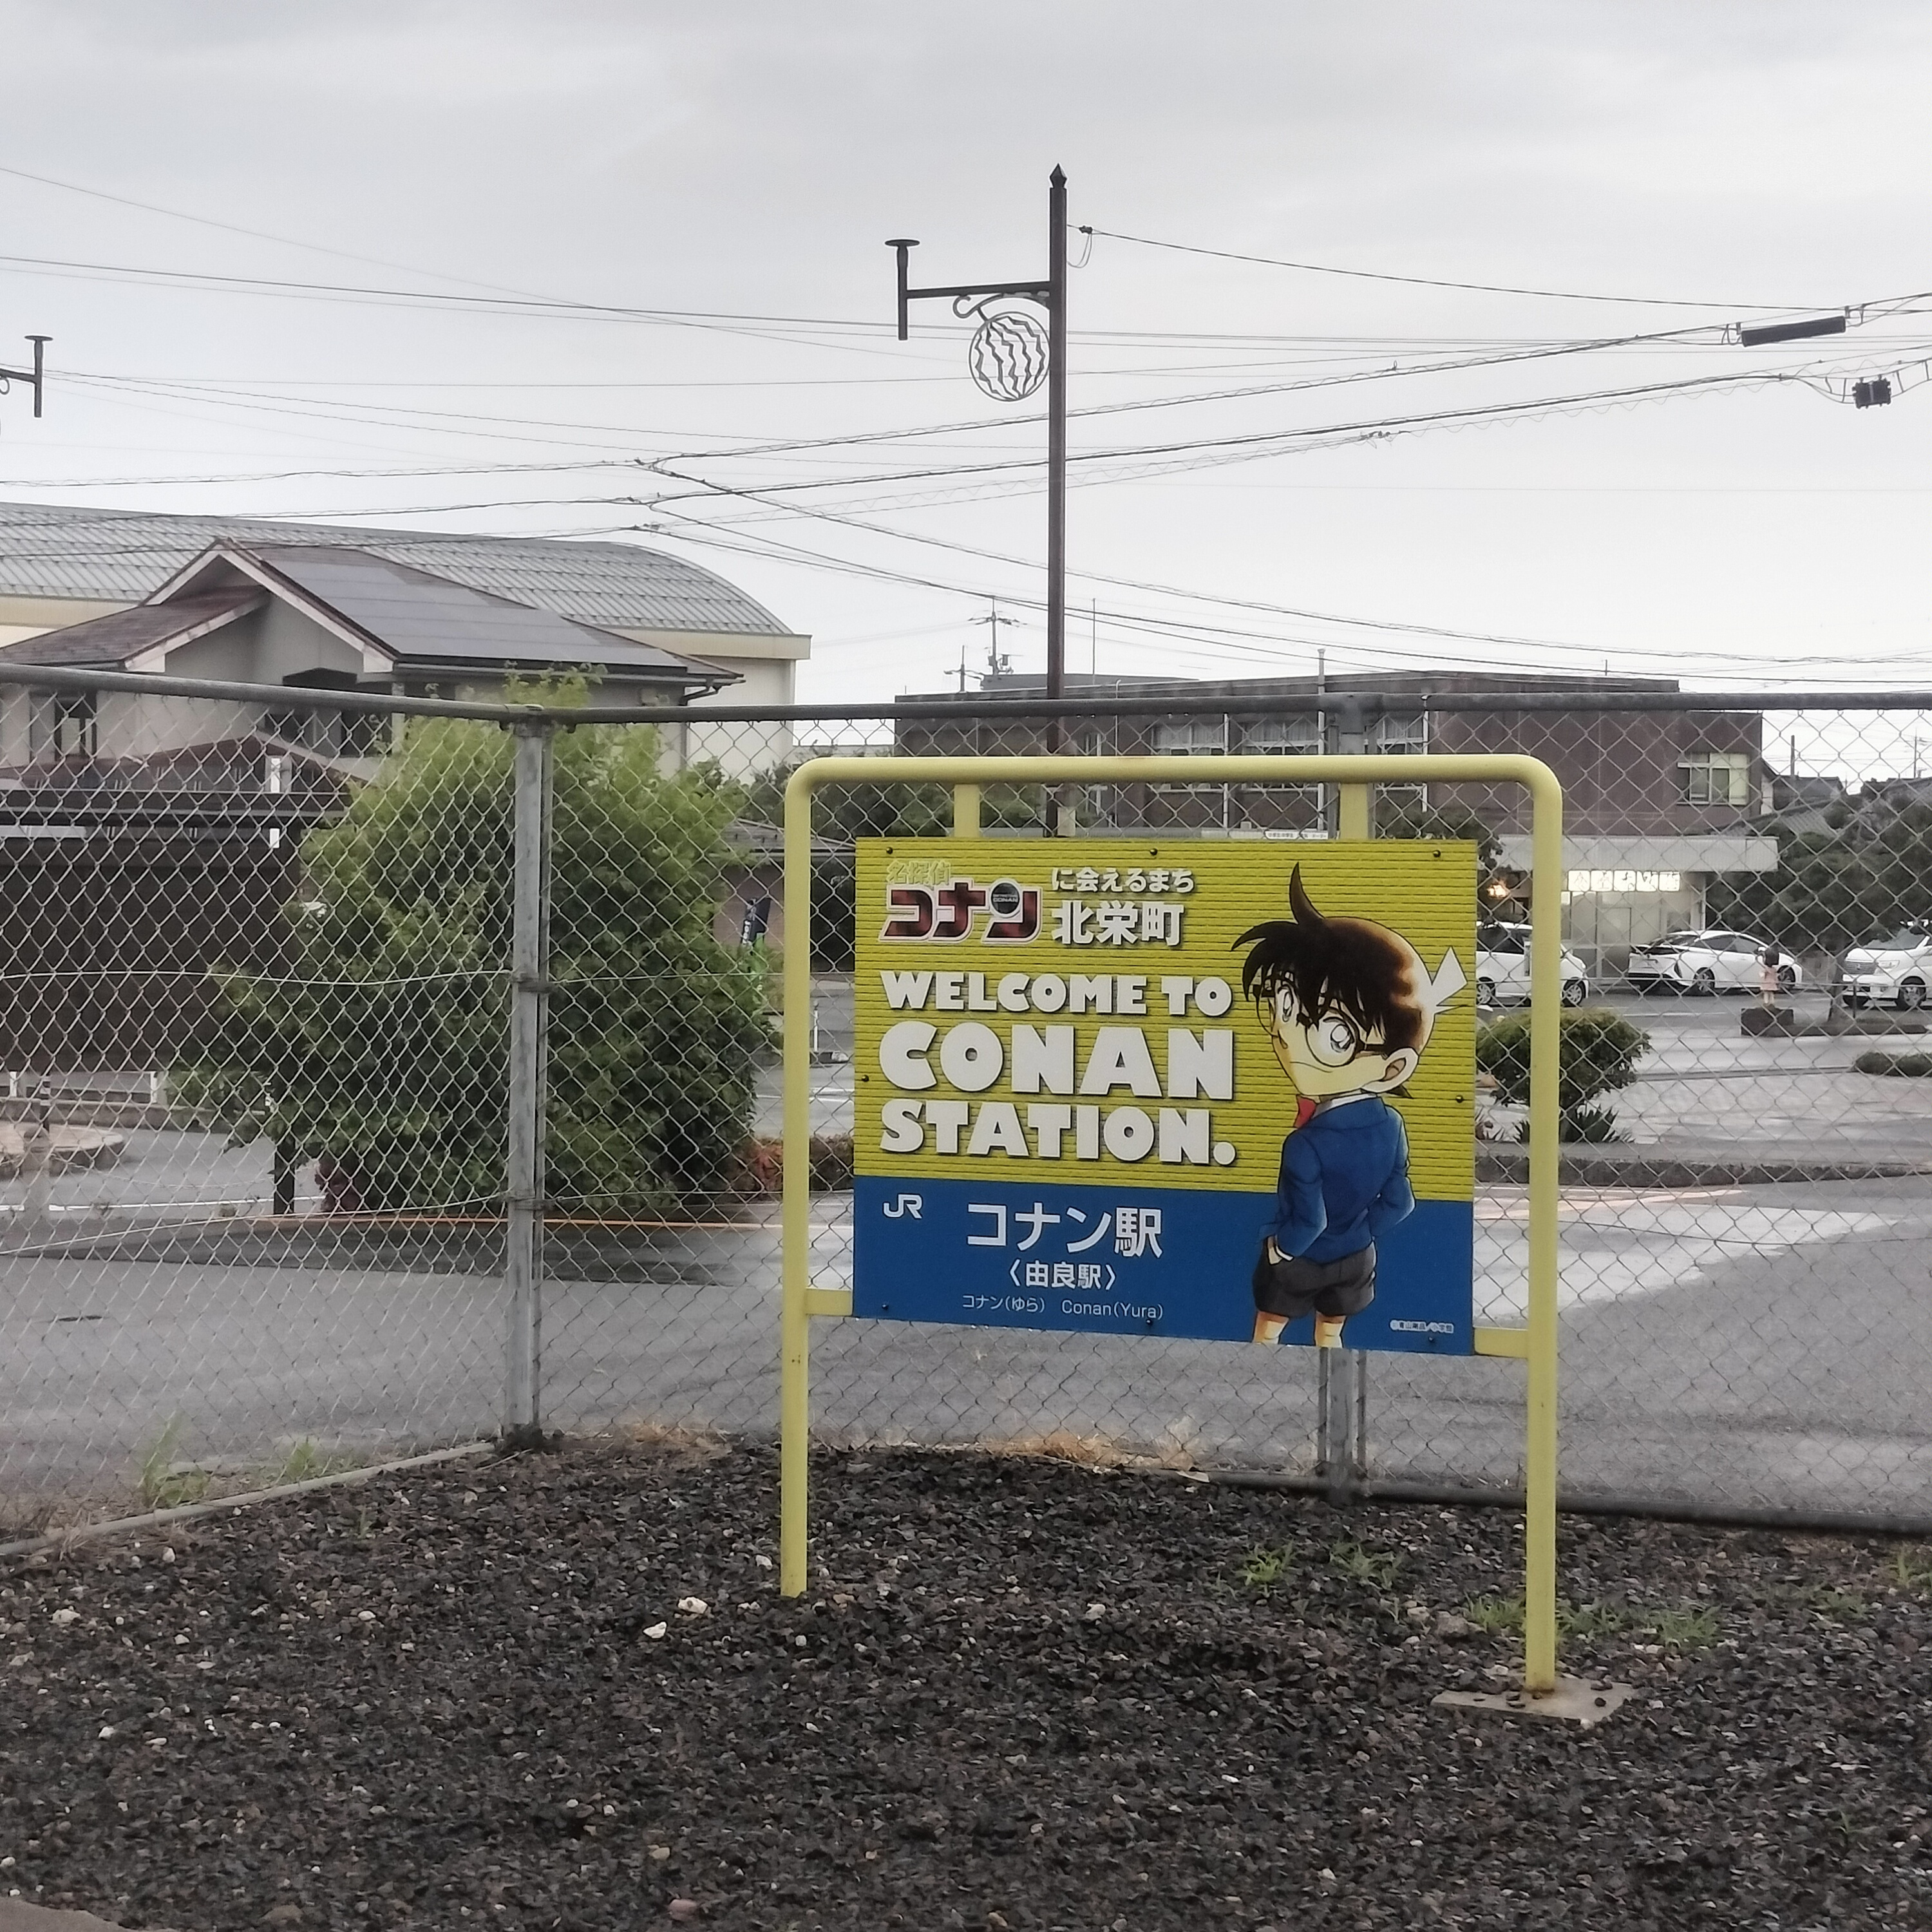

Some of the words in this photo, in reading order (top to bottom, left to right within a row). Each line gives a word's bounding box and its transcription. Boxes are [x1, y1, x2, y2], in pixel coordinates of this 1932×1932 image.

[1052, 867, 1196, 893] に会えるまち
[1052, 900, 1185, 947] 北栄町
[879, 971, 1147, 1016] WELCOME
[1162, 976, 1233, 1017] TO
[879, 1021, 1235, 1100] CONAN
[880, 1099, 1236, 1166] STATION.
[884, 1193, 923, 1219] JR
[968, 1202, 1163, 1258] コナン駅
[1061, 1300, 1164, 1320] Conan(Yura)
